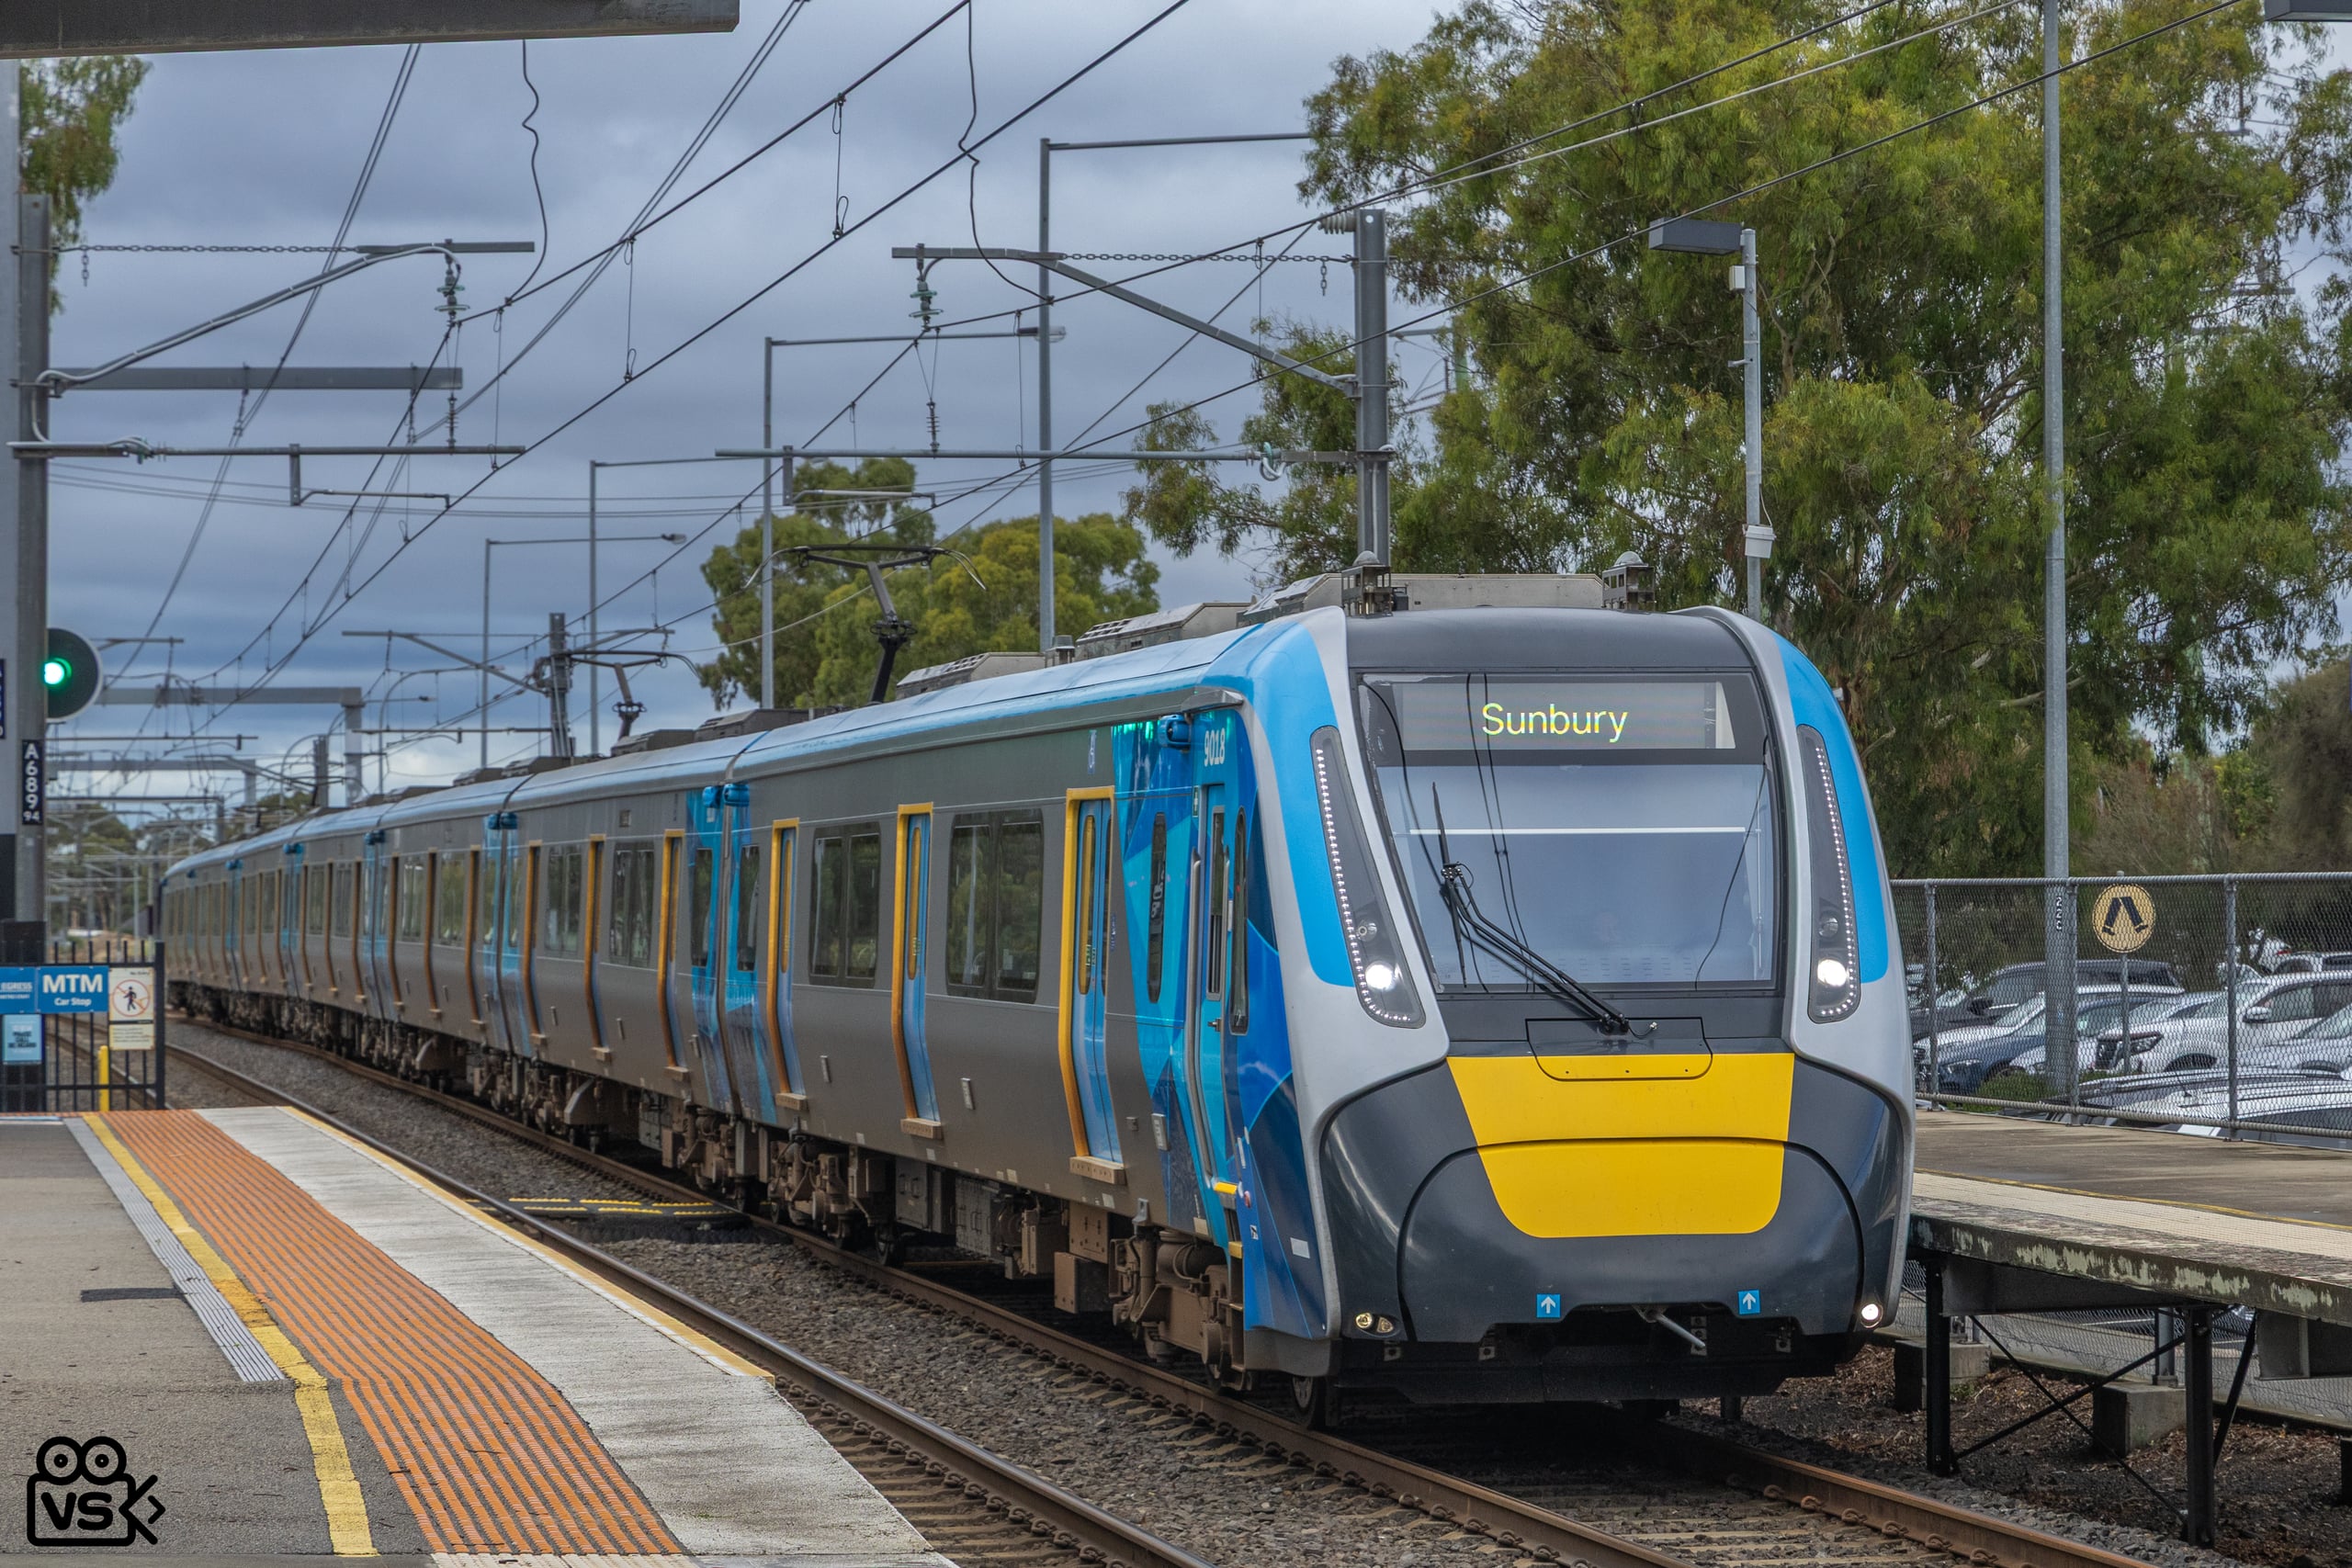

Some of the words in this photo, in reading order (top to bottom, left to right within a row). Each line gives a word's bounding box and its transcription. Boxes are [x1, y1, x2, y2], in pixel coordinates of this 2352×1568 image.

[1482, 702, 1629, 743] Sunbury
[1204, 728, 1226, 767] 9018
[24, 742, 40, 809] A689
[42, 974, 103, 993] MTM
[54, 998, 70, 1006] Car
[71, 998, 92, 1007] Stop
